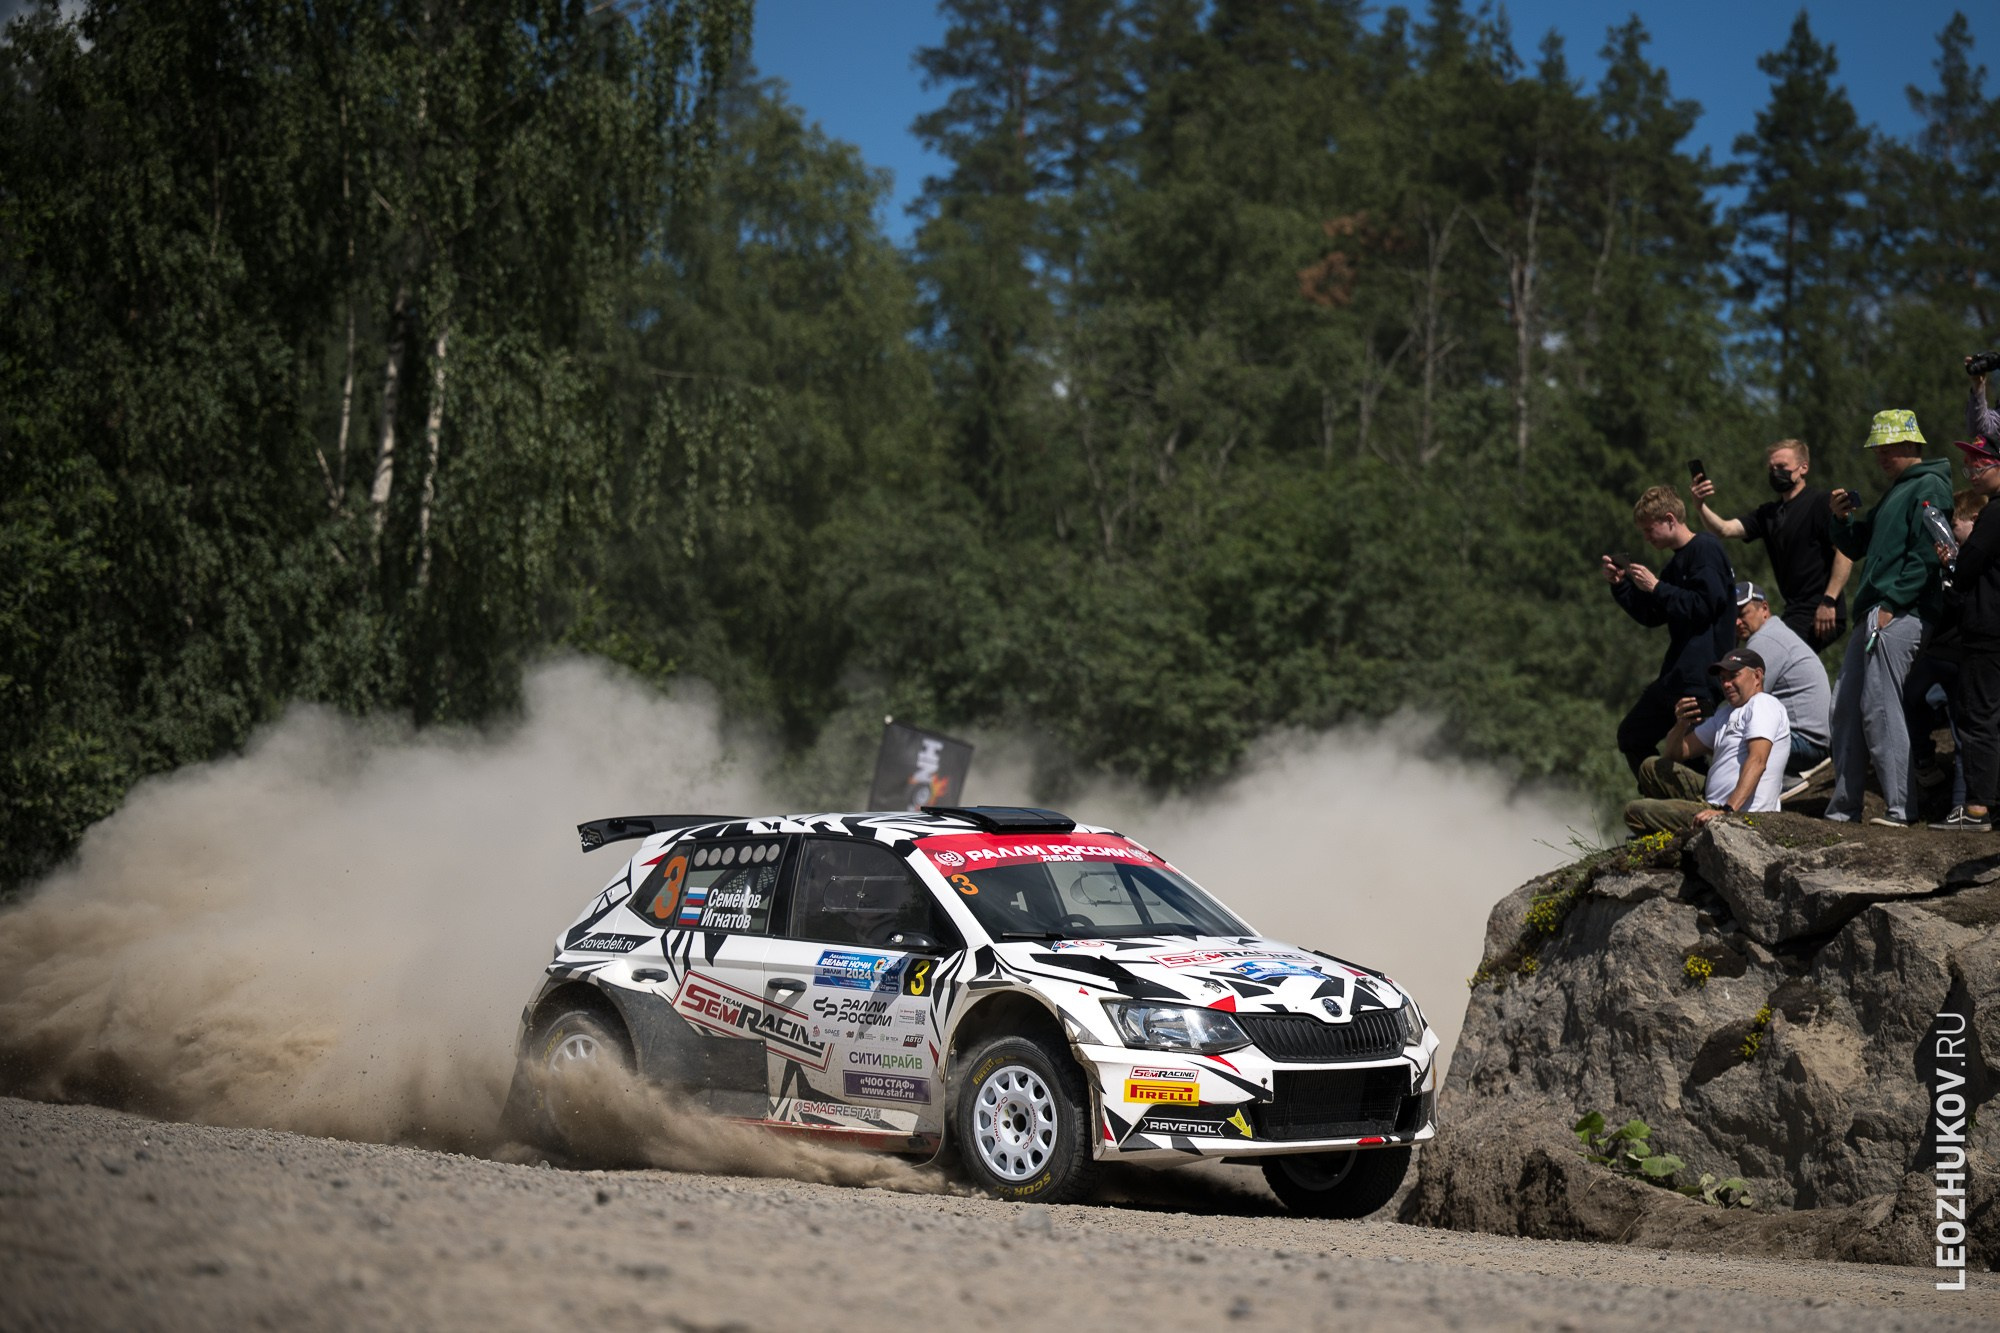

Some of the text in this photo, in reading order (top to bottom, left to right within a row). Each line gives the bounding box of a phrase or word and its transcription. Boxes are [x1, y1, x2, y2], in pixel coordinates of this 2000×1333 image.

[965, 844, 1132, 862] РАЛЛИ РОССИИ
[653, 855, 688, 919] 3
[950, 873, 980, 896] 3
[708, 888, 762, 909] Семёнов
[700, 912, 752, 929] Игнатов
[580, 934, 637, 951] savedeti.ru
[821, 958, 872, 970] БЕЛЫЕ НОЧИ
[846, 968, 872, 980] 2024
[910, 960, 931, 996] 3
[721, 995, 744, 1009] TEAM
[841, 998, 888, 1014] РАЛЛИ
[837, 1012, 893, 1027] РОССИИ
[849, 1051, 923, 1069] СИТИДРАЙВ
[861, 1086, 915, 1099] www.staf.ru
[884, 1078, 915, 1090] СТАФ»
[1130, 1083, 1194, 1102] PIRELLI
[802, 1102, 872, 1119] SMAGRESTA
[1149, 1120, 1217, 1134] RAVENOL
